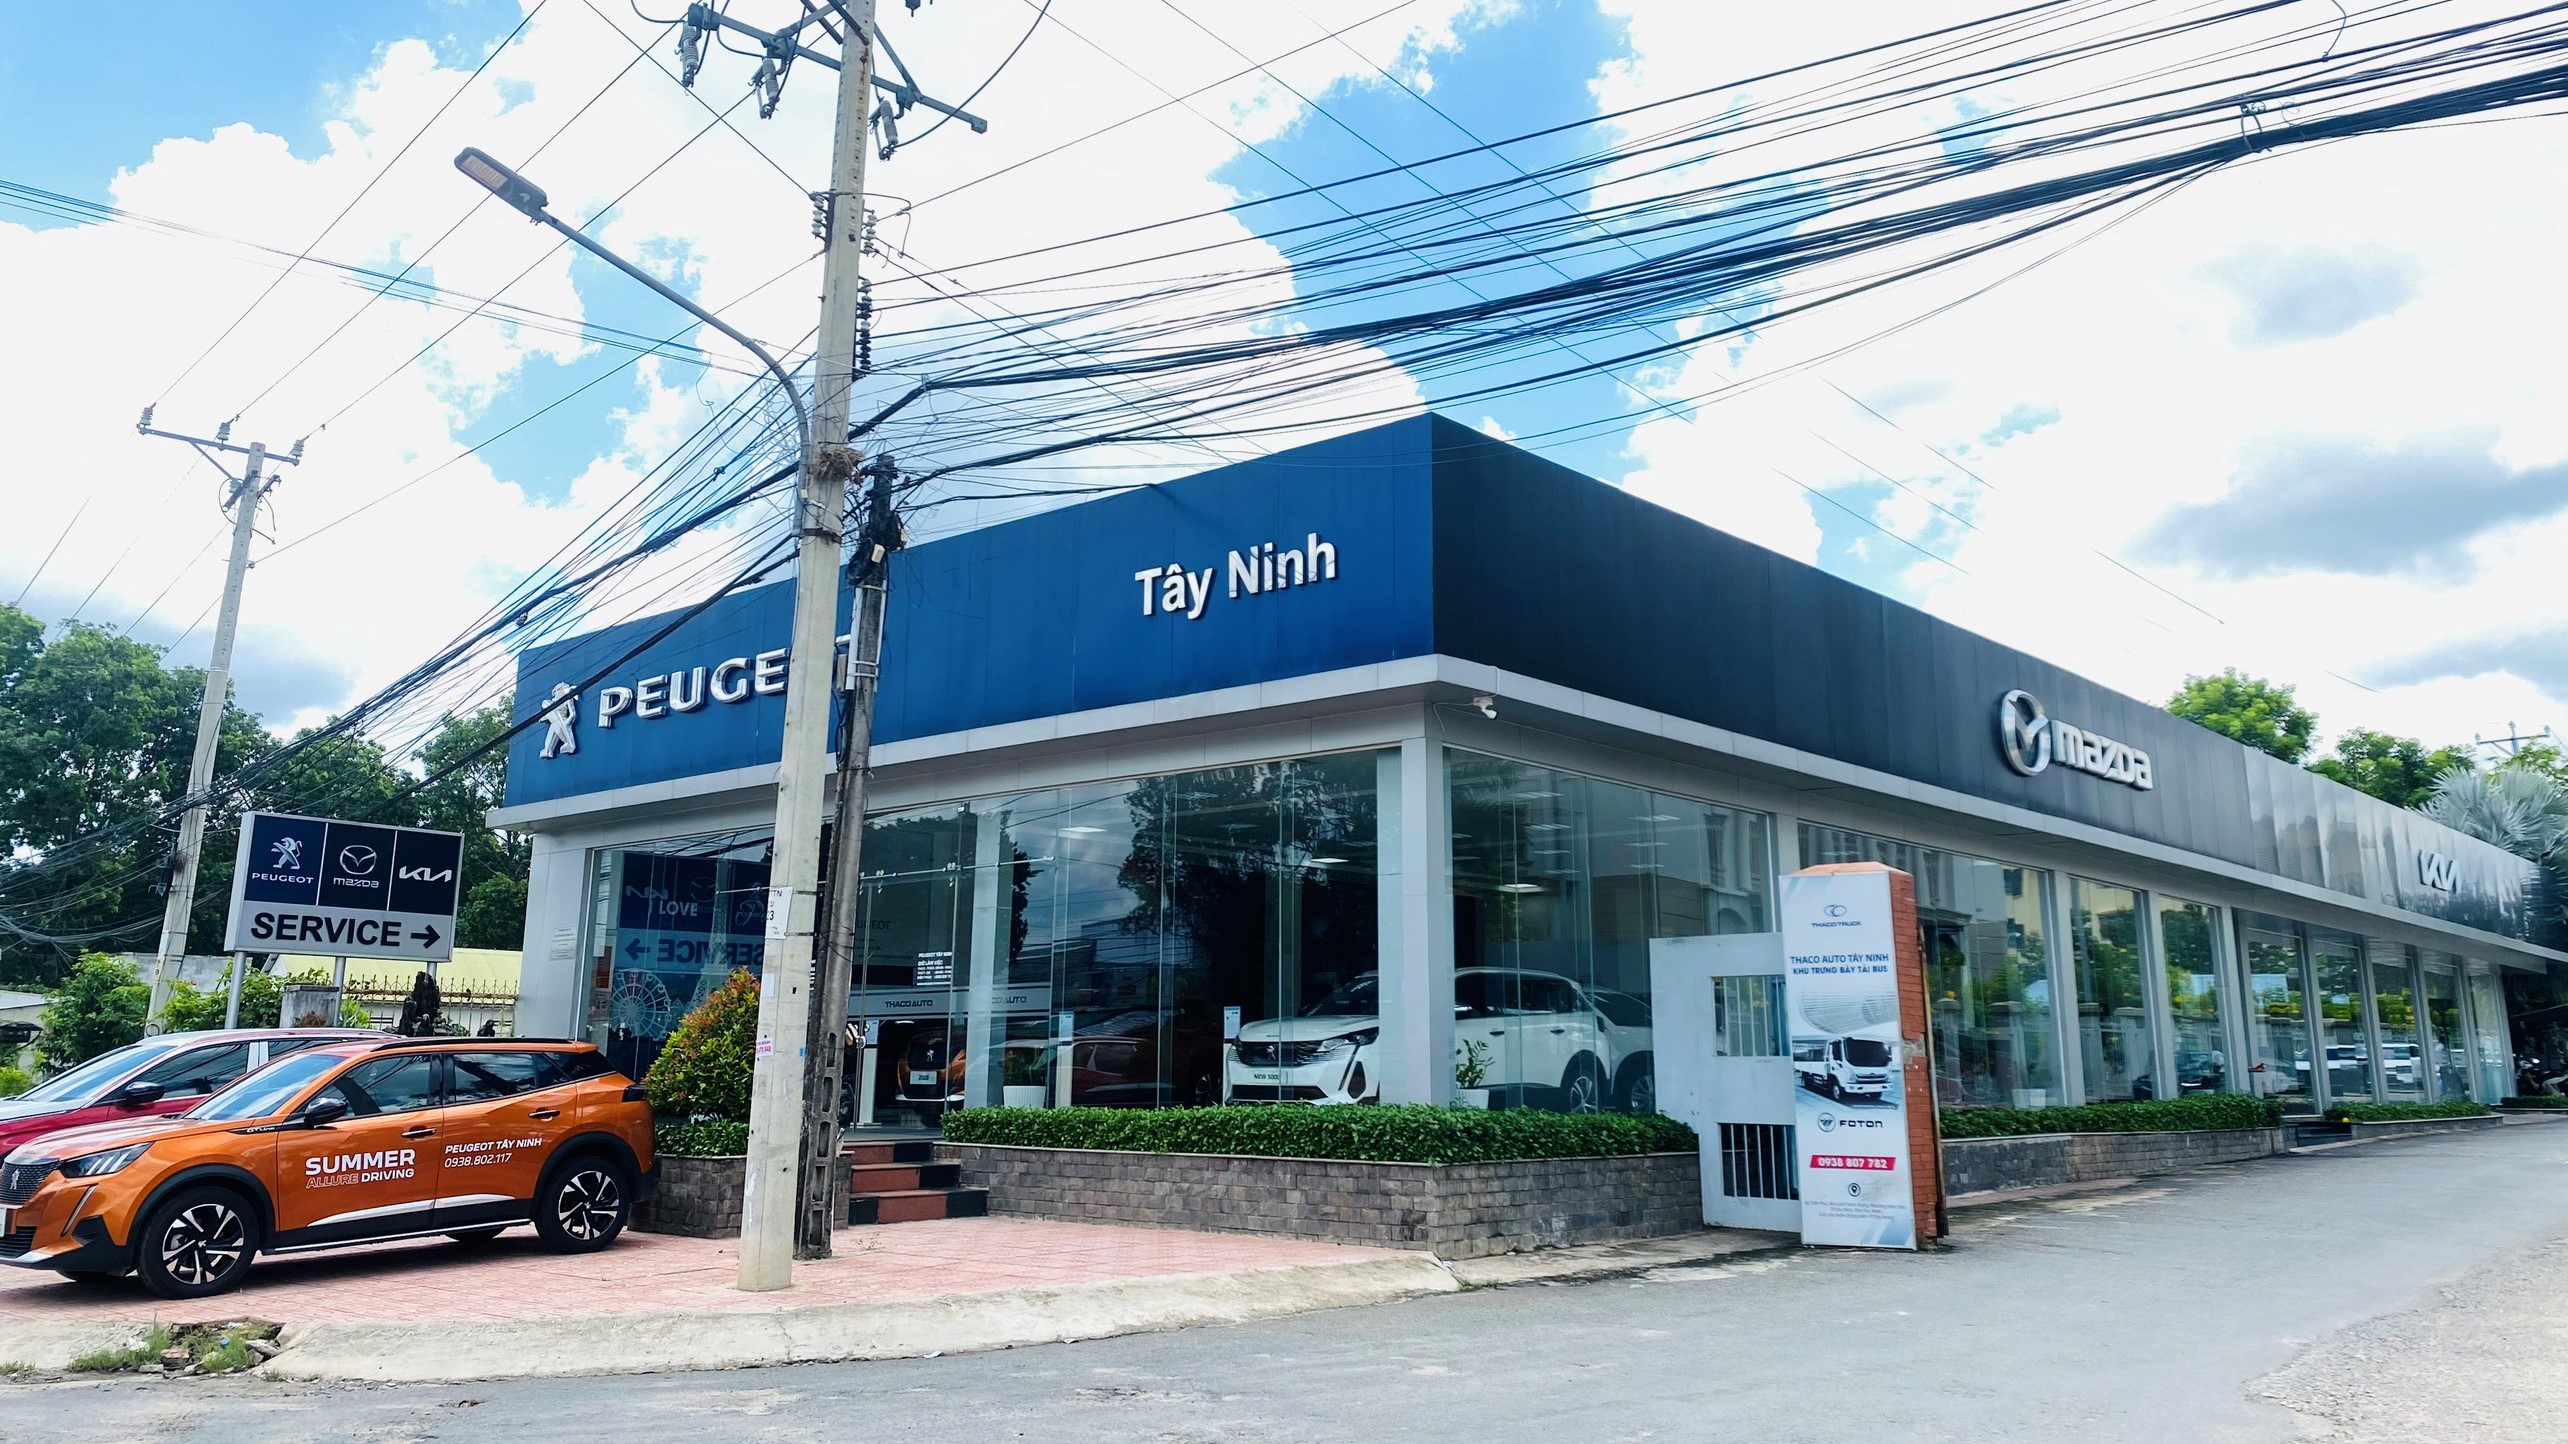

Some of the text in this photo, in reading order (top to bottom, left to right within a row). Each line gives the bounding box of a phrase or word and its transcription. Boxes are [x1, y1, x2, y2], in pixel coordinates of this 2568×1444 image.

[1135, 532, 1336, 620] Tây Ninh
[597, 634, 850, 729] PEUGE
[252, 872, 314, 884] PEUGEOT
[659, 900, 698, 917] LOVE
[250, 911, 402, 947] SERVICE
[1790, 956, 1820, 964] THACO
[1822, 954, 1846, 963] AUTO
[1866, 953, 1889, 962] NINH
[913, 999, 933, 1007] AUTO
[445, 1138, 542, 1155] PEUGEOT TÂY NINH
[305, 1149, 416, 1176] SUMMER
[444, 1152, 512, 1168] 0938.802.117
[306, 1168, 415, 1189] ALLURE DRIVING
